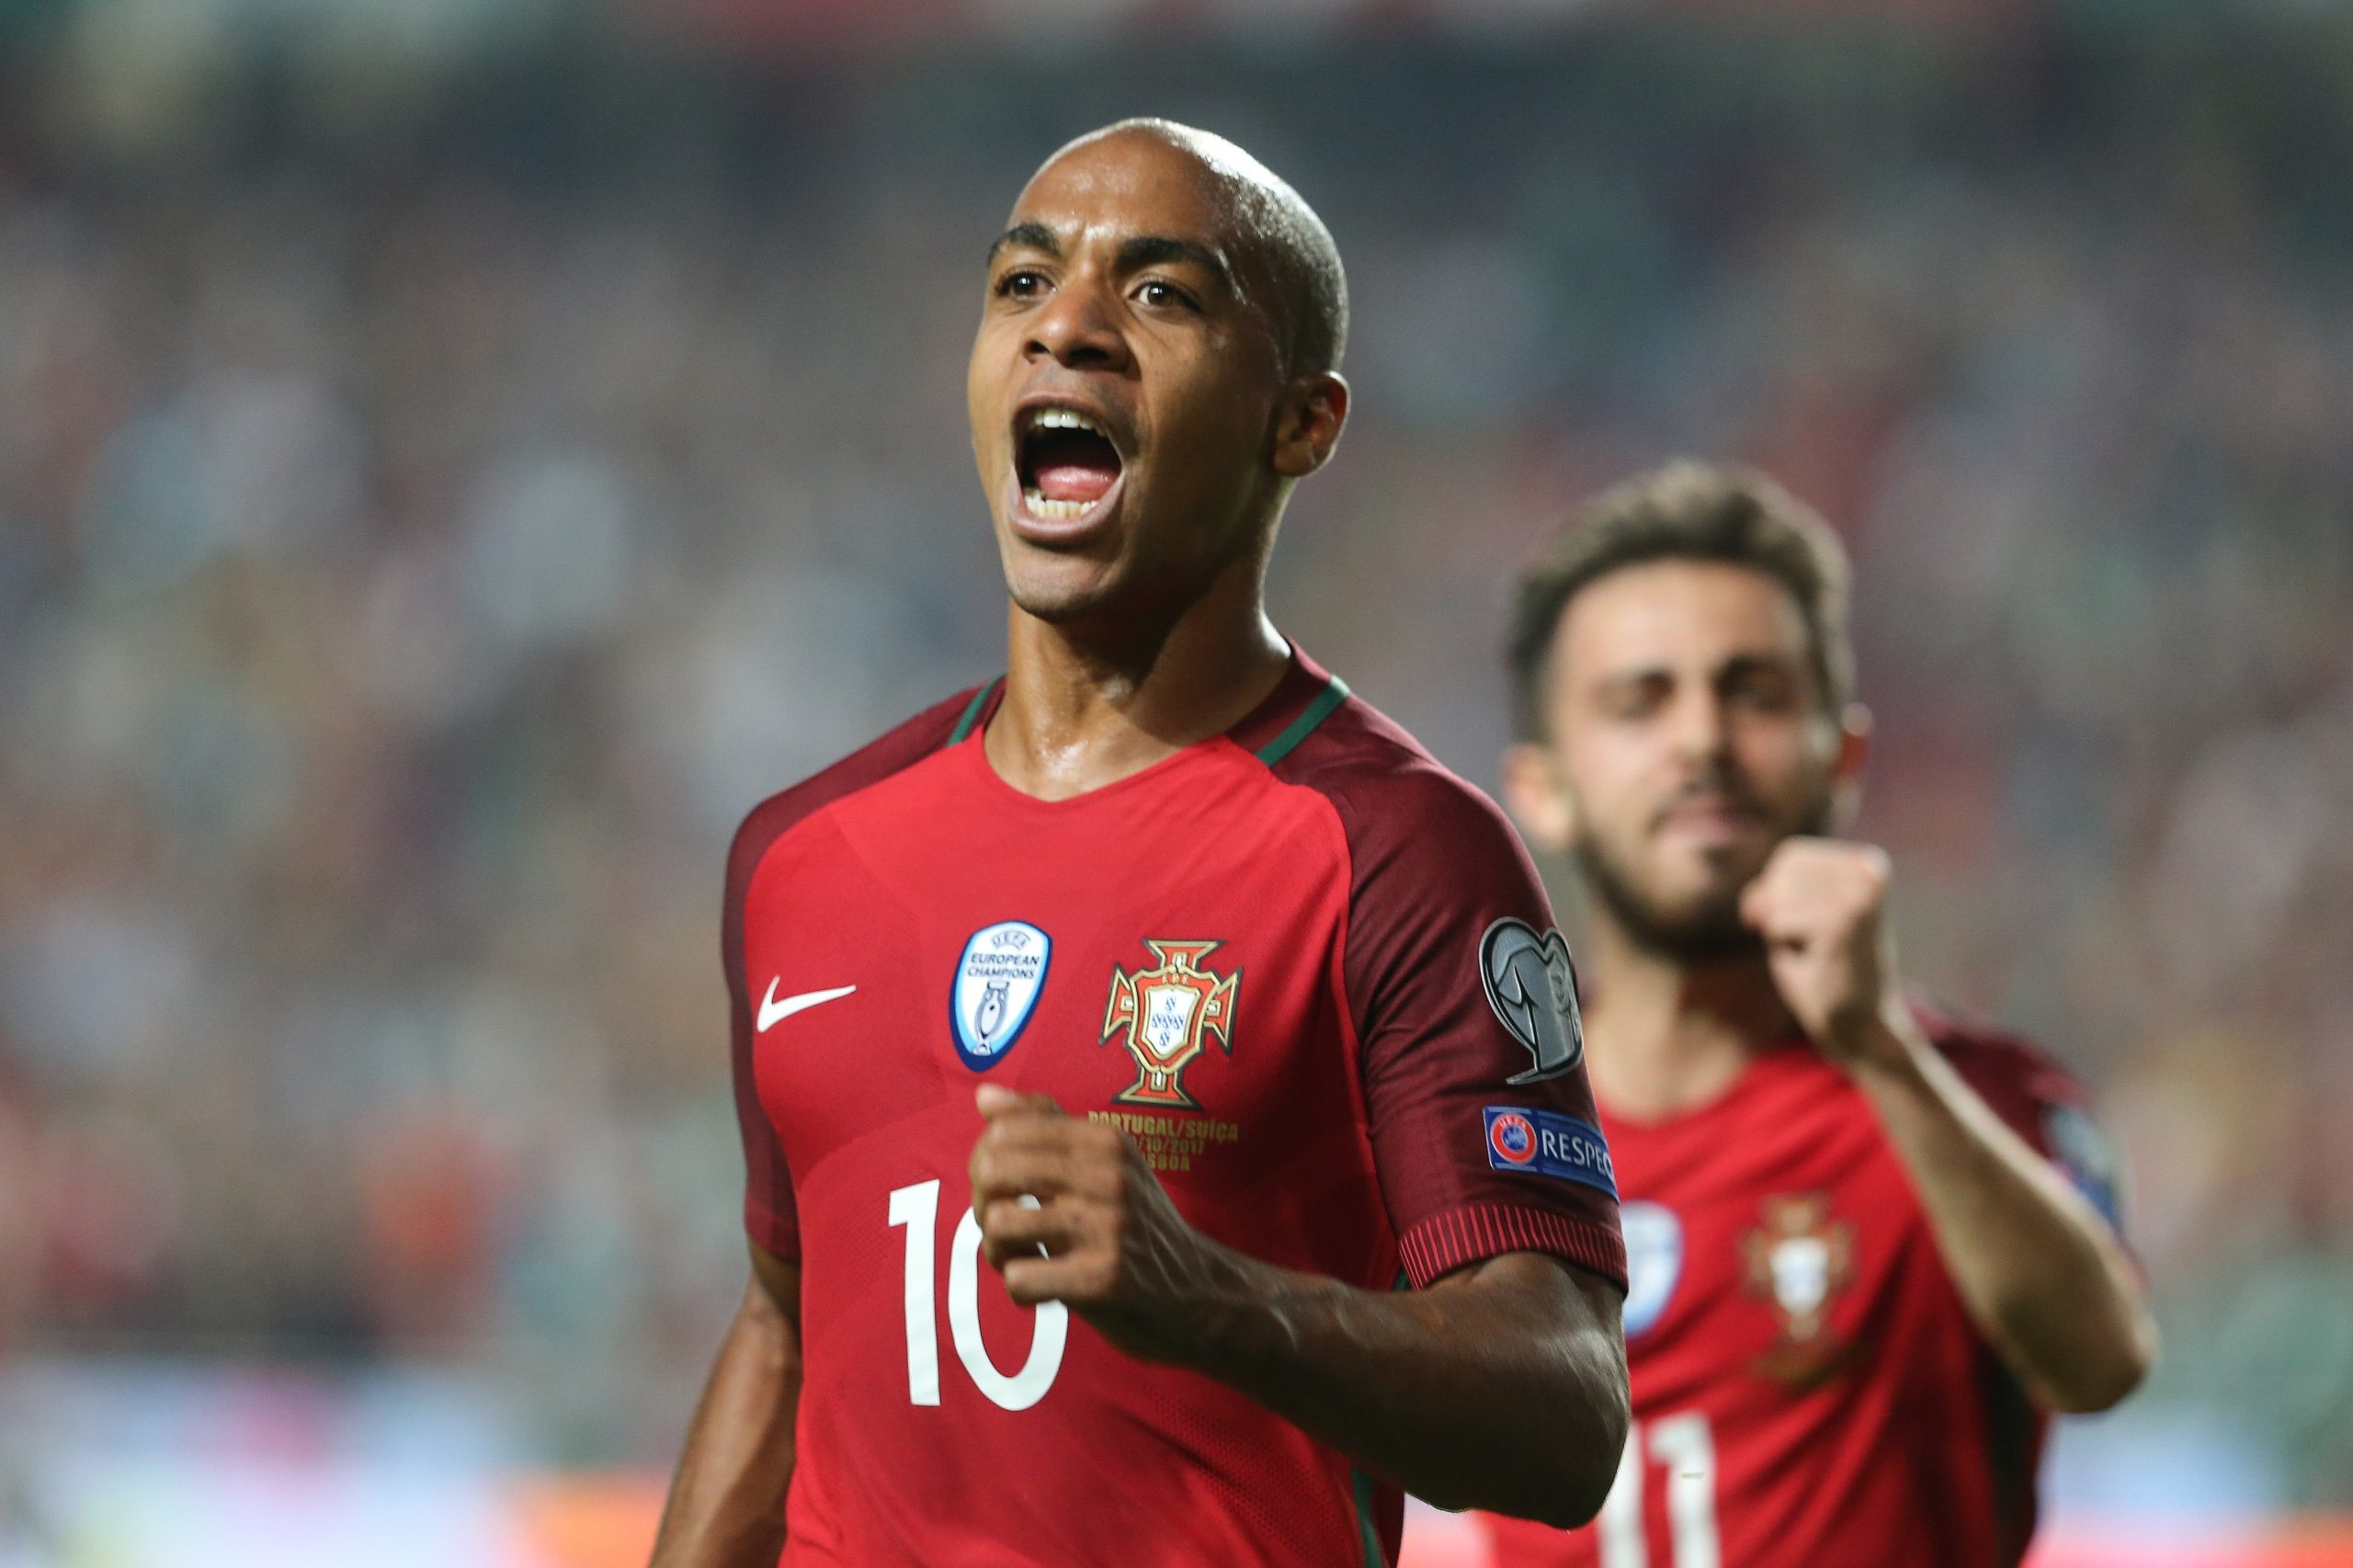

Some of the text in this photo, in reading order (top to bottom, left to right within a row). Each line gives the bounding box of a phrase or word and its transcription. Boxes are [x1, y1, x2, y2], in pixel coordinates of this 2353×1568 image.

[992, 930, 1030, 949] UEFA
[971, 952, 1040, 966] EUROPEAN
[967, 967, 1035, 980] CHAMPIONS
[1131, 1133, 1206, 1155] /10/2017
[1541, 1128, 1614, 1179] RESPEC
[1145, 1152, 1190, 1172] SBOA
[888, 1178, 1070, 1411] 10
[1596, 1411, 1722, 1568] 11
